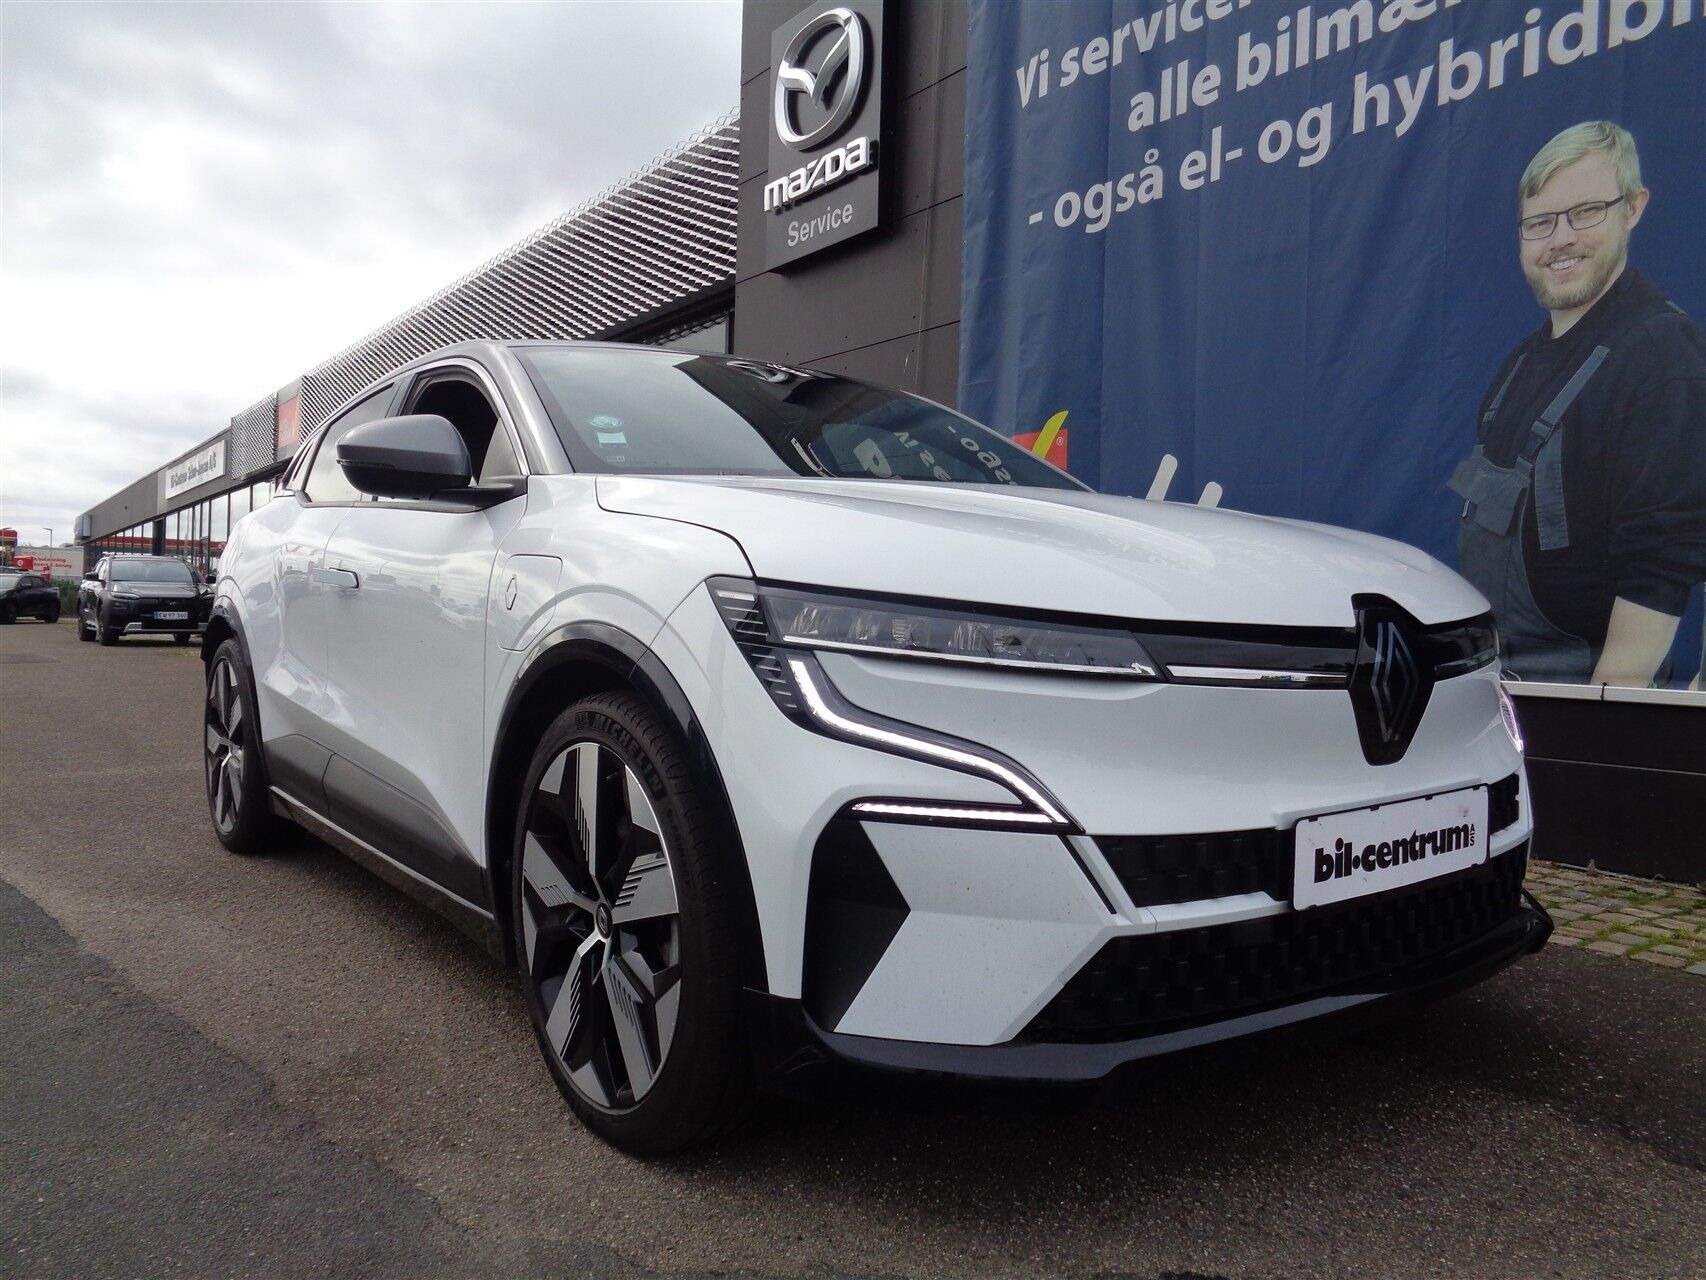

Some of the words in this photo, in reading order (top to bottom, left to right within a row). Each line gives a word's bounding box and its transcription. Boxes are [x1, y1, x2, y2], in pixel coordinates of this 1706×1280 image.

[1016, 48, 1049, 109] Vi
[1127, 59, 1221, 132] alle
[1236, 0, 1461, 92] bilmæ
[1053, 148, 1163, 234] også
[1179, 126, 1242, 190] el-
[1257, 102, 1333, 168] og
[787, 203, 853, 247] Service
